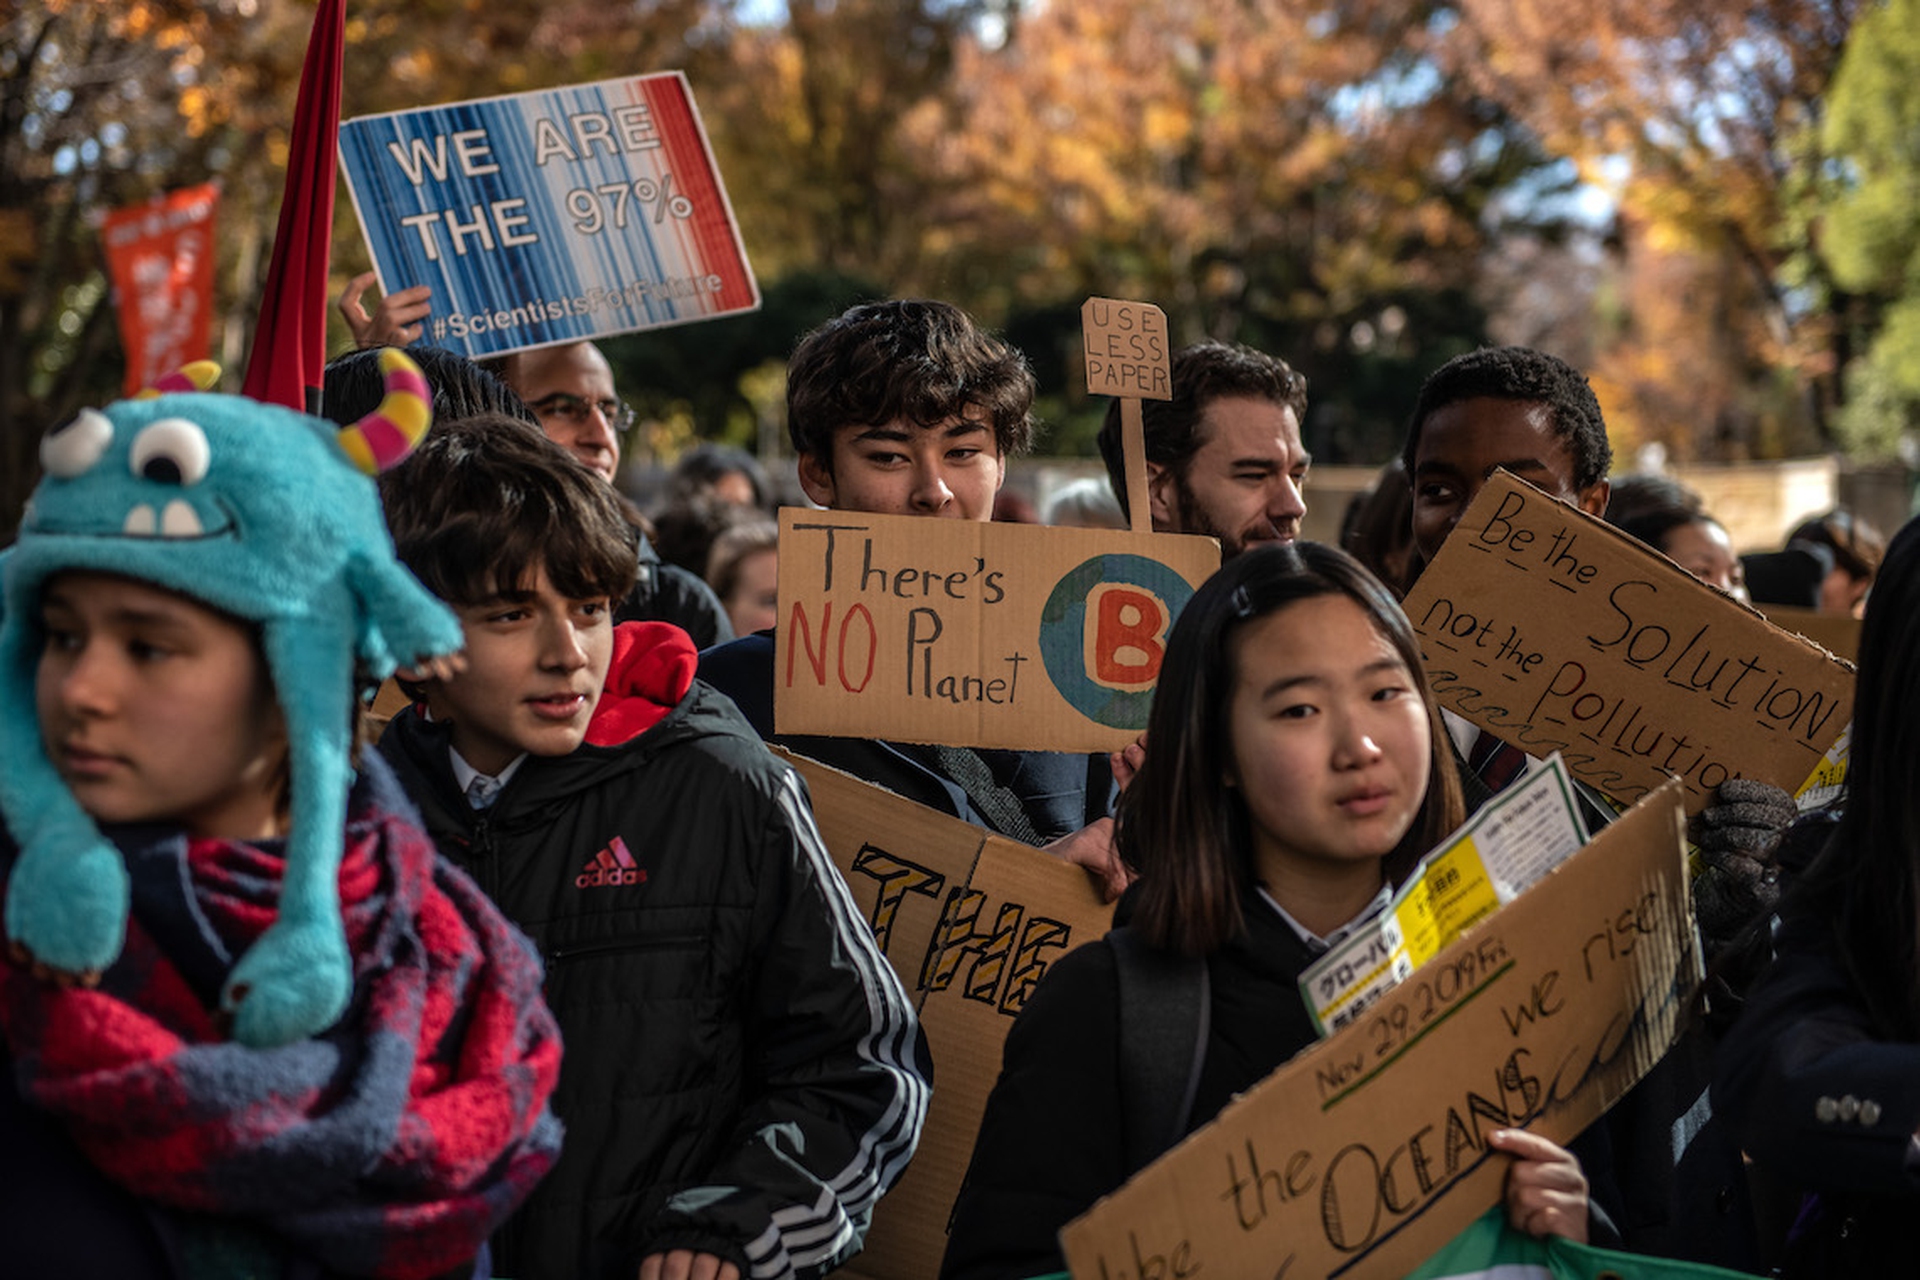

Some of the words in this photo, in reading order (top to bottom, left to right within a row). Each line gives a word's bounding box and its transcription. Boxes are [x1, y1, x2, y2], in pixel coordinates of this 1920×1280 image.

[388, 129, 499, 187] WE
[535, 104, 662, 167] ARE
[401, 197, 539, 262] THE
[566, 174, 694, 236] 97%
[432, 271, 723, 341] #ScientistsForFuture
[1086, 332, 1163, 363] LESS
[1092, 303, 1158, 333] USE
[1089, 360, 1168, 393] PAPER
[793, 523, 1006, 604] There's
[1478, 490, 1536, 552] Be
[1543, 526, 1598, 585] the
[786, 600, 878, 693] NO
[907, 607, 1029, 704] Planet
[1096, 588, 1167, 684] B
[1420, 598, 1494, 648] not
[1494, 626, 1544, 674] the
[1526, 660, 1743, 787] Pollutio
[575, 867, 647, 889] adidas
[851, 842, 1071, 1018] THE
[1500, 969, 1567, 1038] we
[1582, 891, 1660, 983] rise
[1315, 1051, 1364, 1097] Nov
[1220, 1137, 1319, 1234] the
